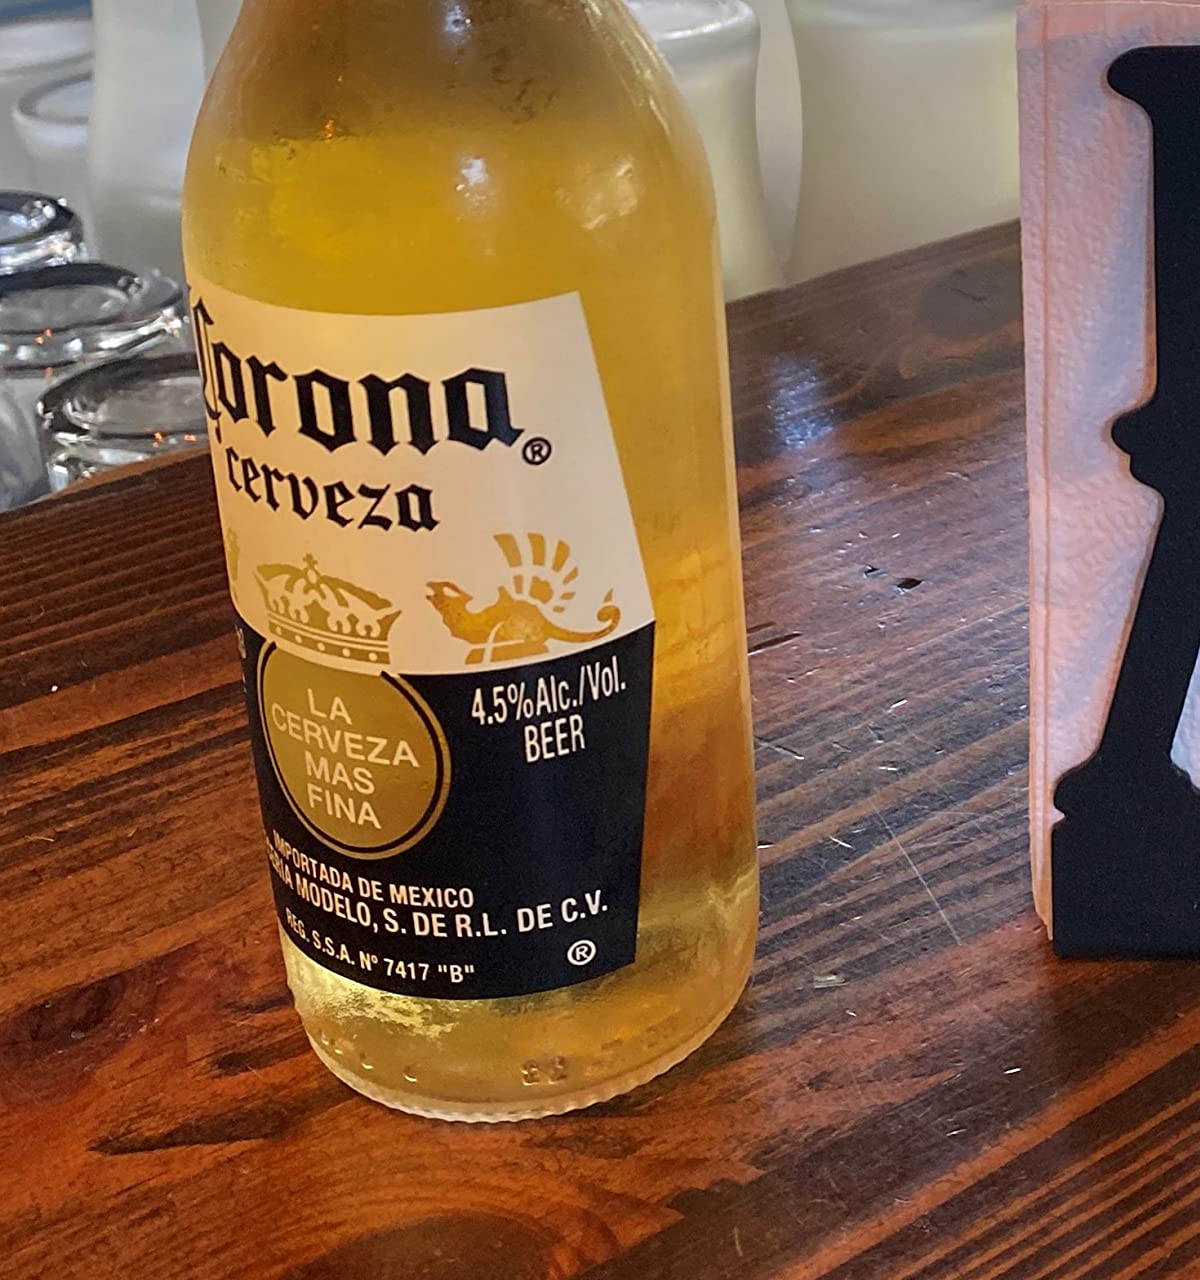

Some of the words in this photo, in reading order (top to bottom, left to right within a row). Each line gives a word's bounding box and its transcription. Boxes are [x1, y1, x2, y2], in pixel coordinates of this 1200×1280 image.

[193, 296, 525, 456] Corona
[225, 446, 440, 532] cerveza
[271, 702, 420, 768] CERVEZA
[307, 687, 353, 726] LA
[523, 713, 586, 763] BEER
[304, 750, 376, 796] MAS
[306, 782, 382, 830] FINA
[273, 829, 354, 894] IMPORTADA
[357, 876, 385, 902] DE
[389, 883, 475, 909] MEXICO
[295, 872, 379, 934] MODELO,
[382, 907, 407, 935] S.
[412, 911, 449, 938] DE
[455, 912, 507, 938] R.L.
[516, 903, 554, 933] DE
[560, 889, 608, 924] C.V.
[383, 957, 430, 982] 7417
